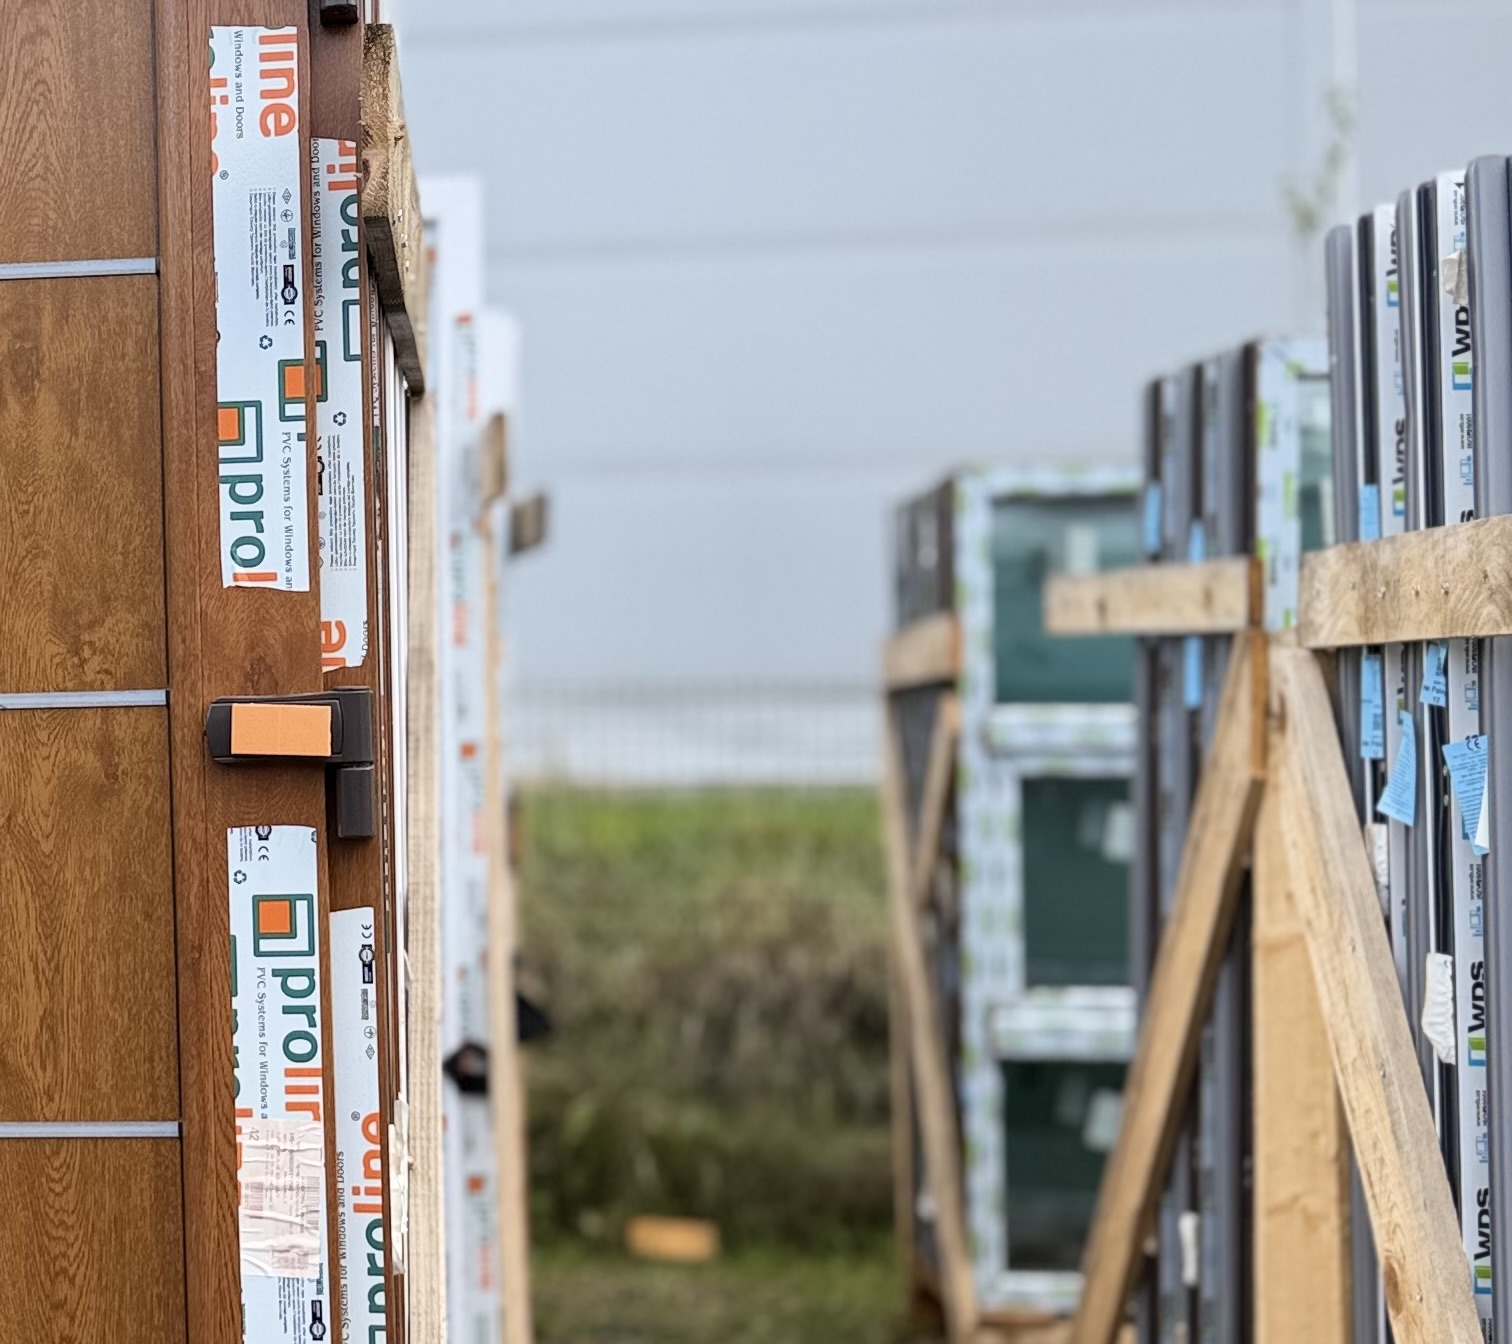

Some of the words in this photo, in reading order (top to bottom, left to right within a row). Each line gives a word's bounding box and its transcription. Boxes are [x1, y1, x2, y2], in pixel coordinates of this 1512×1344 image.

[233, 29, 244, 79] Windows
[234, 81, 244, 103] and
[258, 34, 298, 138] line
[235, 106, 245, 139] Doors
[1452, 304, 1472, 358] WD
[281, 431, 292, 454] PVC
[280, 456, 292, 503] Systems
[219, 473, 278, 583] prol
[283, 505, 293, 521] for
[283, 524, 294, 573] Windows
[285, 575, 293, 589] an
[256, 966, 267, 989] PVC
[1468, 960, 1486, 1034] WDS
[254, 991, 267, 1038] Systems
[258, 1041, 268, 1057] for
[271, 967, 322, 1122] proli
[259, 1060, 269, 1110] Windows
[1474, 1187, 1492, 1262] WDS
